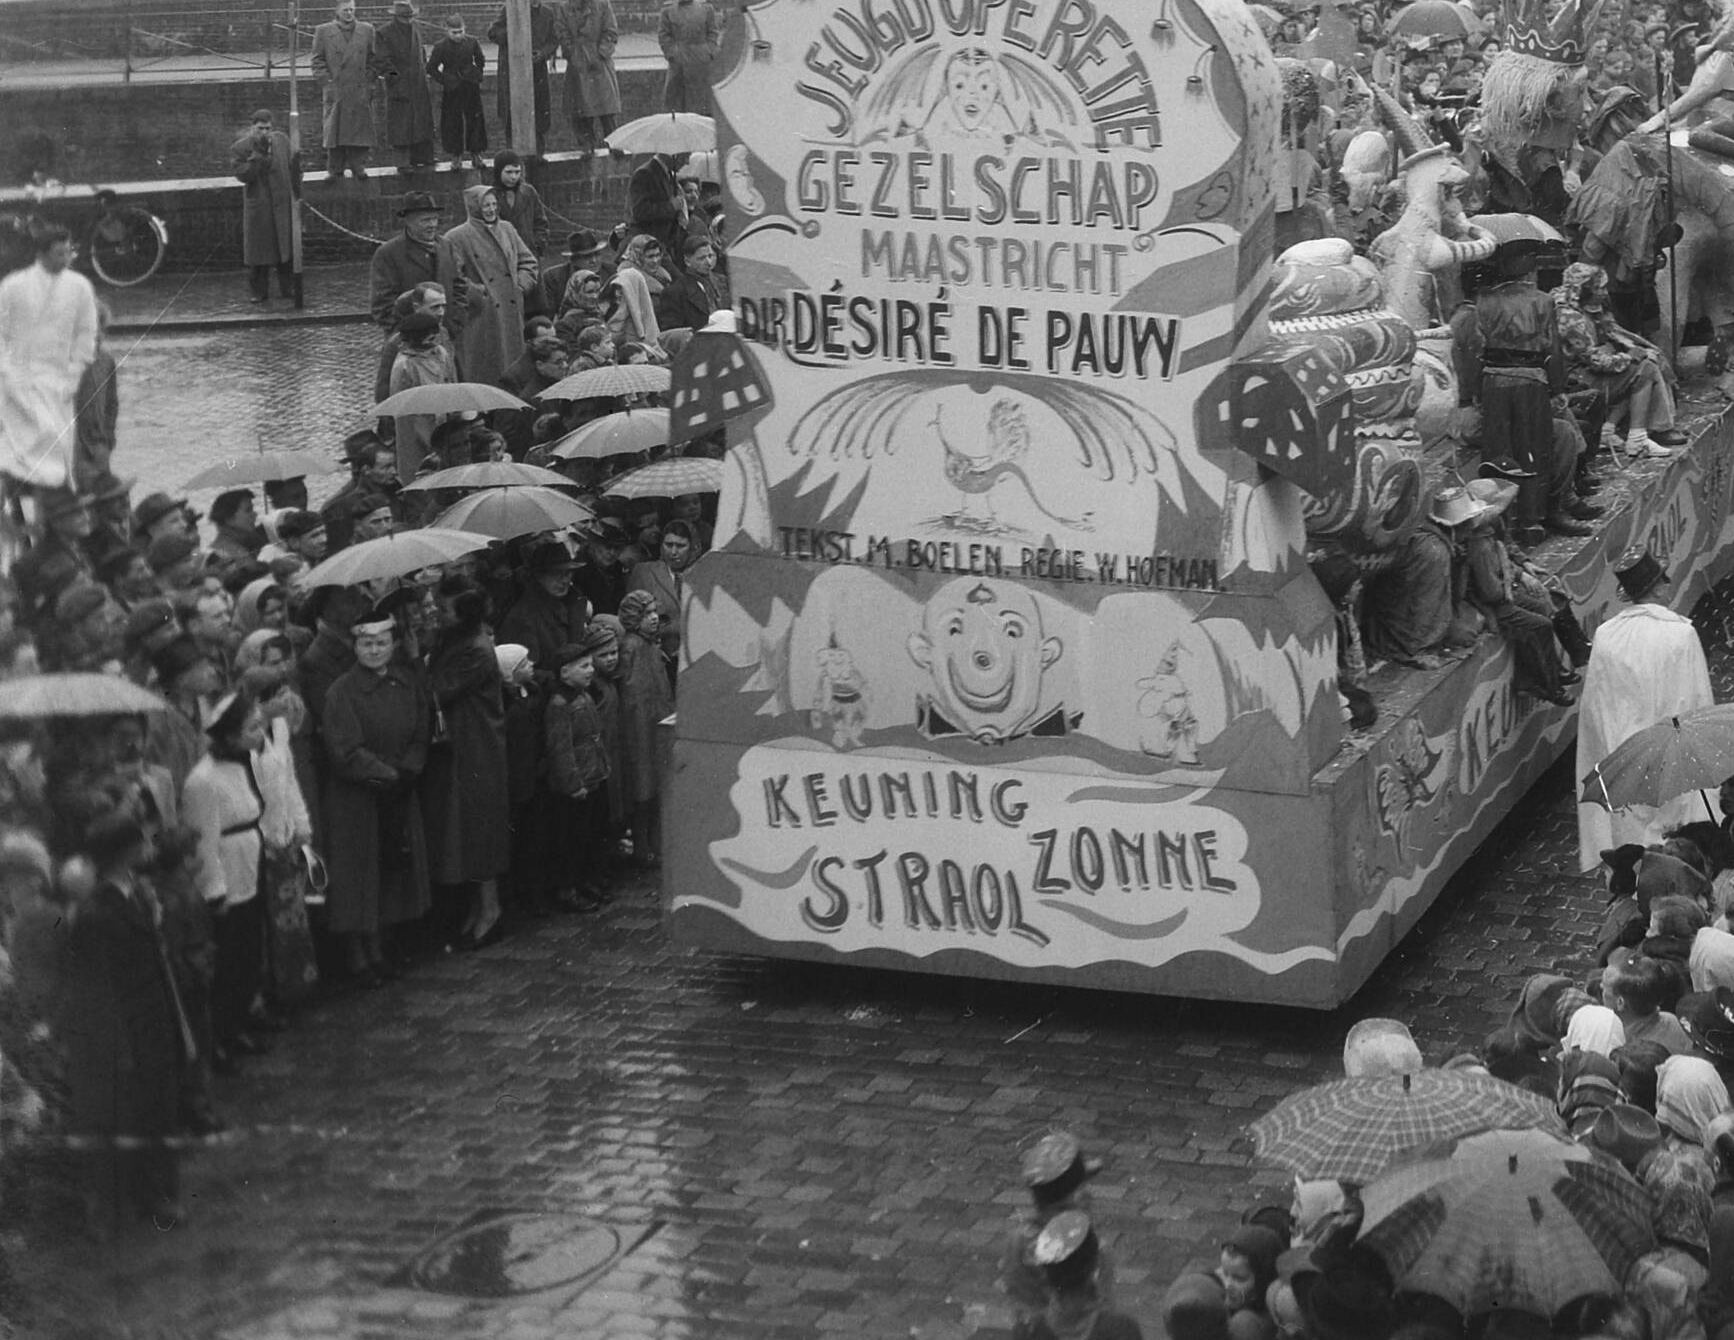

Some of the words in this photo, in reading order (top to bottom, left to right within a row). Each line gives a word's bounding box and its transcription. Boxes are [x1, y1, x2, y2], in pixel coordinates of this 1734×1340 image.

[798, 150, 1158, 230] GEZELSCHAP
[861, 229, 1128, 296] MAASTRICHT
[792, 278, 957, 367] DÉSIRÉ
[978, 306, 1031, 371] DE
[1046, 311, 1180, 380] PAUW
[763, 771, 1028, 828] KEUNING
[1028, 826, 1236, 894] ZONNE
[801, 848, 1050, 947] STRAOL
